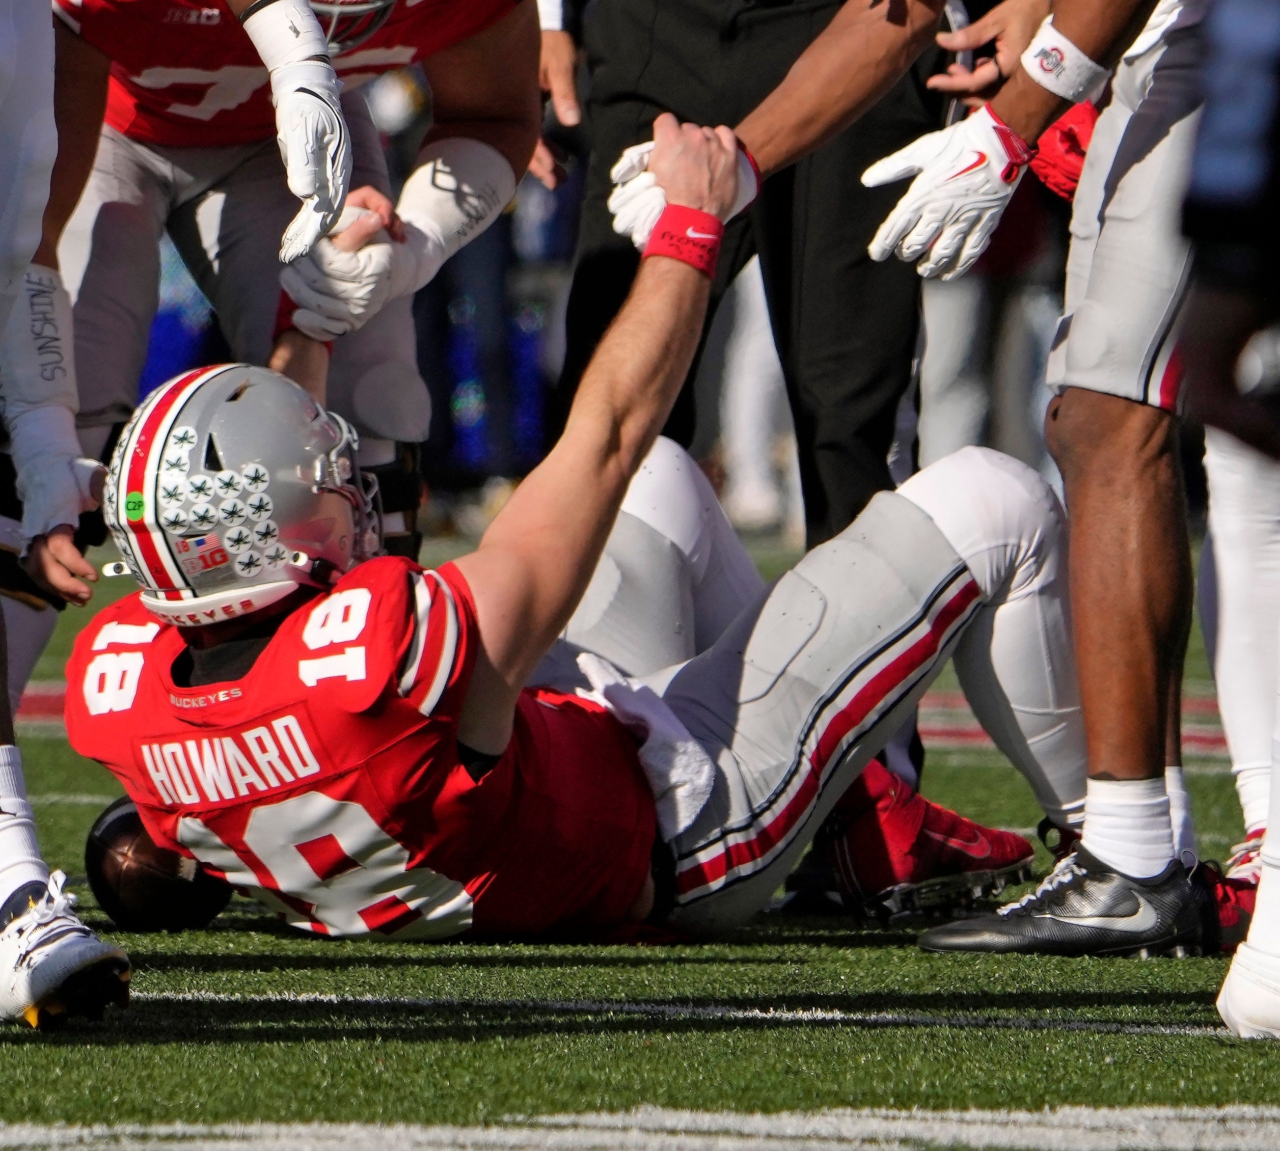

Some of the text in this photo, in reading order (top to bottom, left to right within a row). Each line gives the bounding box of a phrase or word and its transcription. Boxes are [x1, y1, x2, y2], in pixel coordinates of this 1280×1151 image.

[25, 272, 67, 382] SUNSHINE
[126, 501, 144, 511] C2P
[82, 621, 161, 716] 18
[298, 587, 372, 687] 18
[169, 688, 243, 709] BUCKEYES
[140, 714, 320, 806] HOWARD
[176, 791, 474, 944] 18
